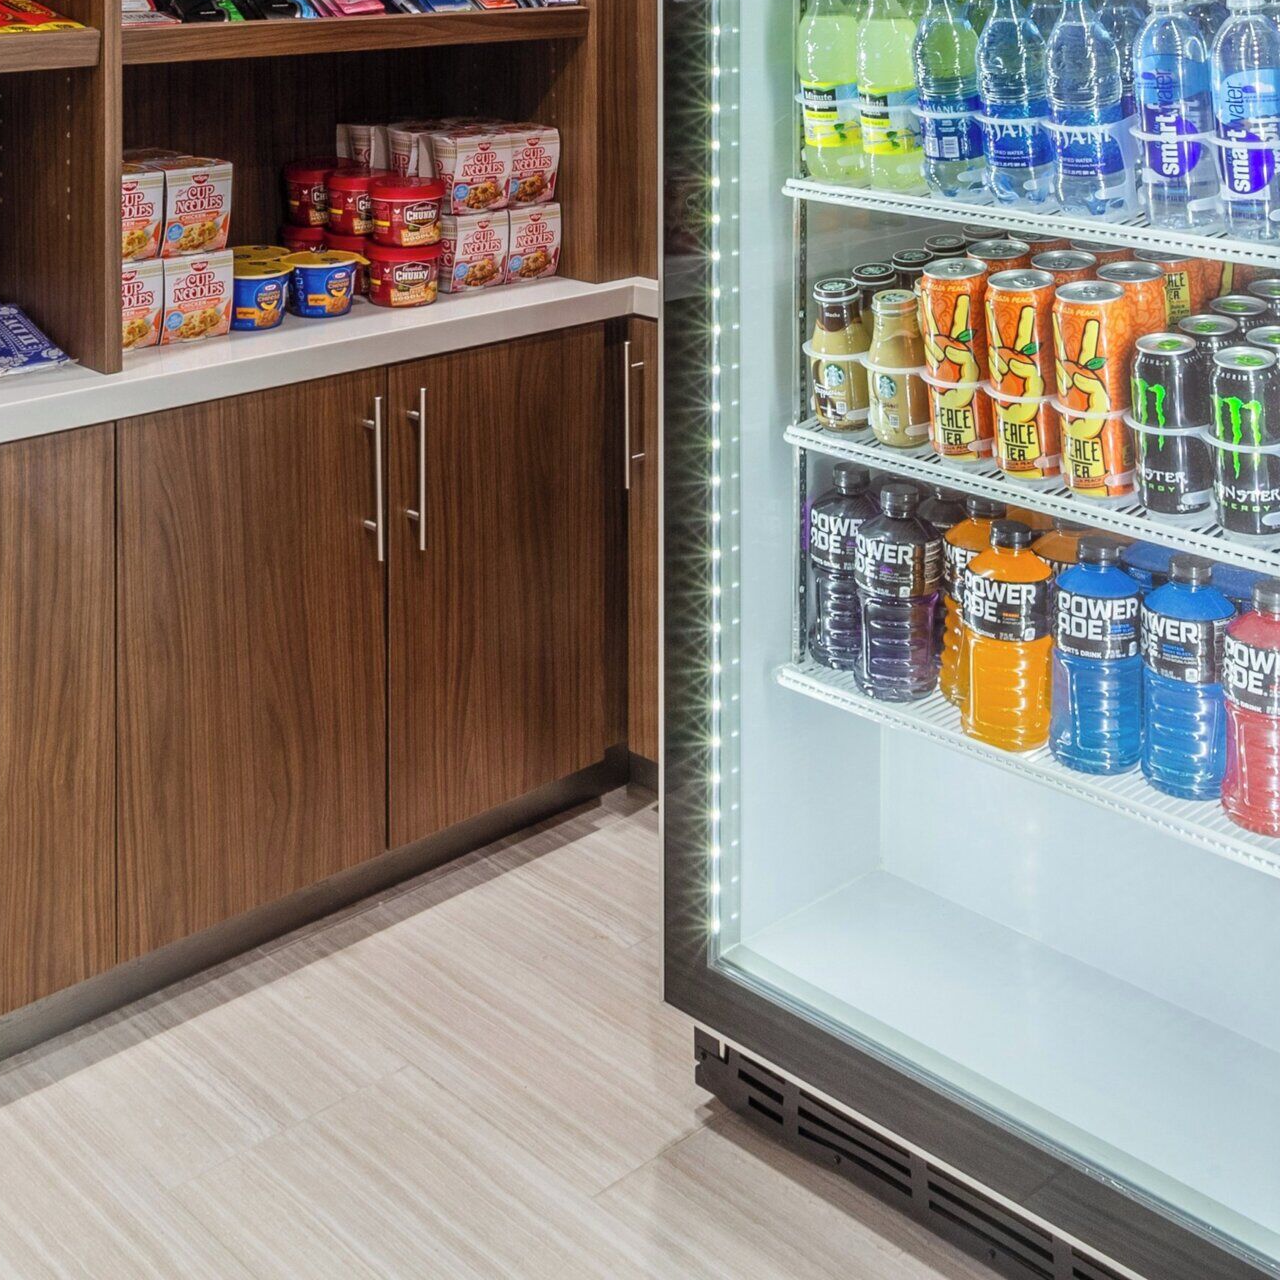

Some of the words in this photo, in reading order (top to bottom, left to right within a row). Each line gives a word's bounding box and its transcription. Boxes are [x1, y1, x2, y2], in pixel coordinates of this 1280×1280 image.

[473, 152, 496, 164] CUP
[522, 147, 545, 159] CUP
[462, 162, 504, 177] NOODLES
[512, 157, 552, 171] NOODLES
[187, 185, 215, 200] CUP
[175, 196, 223, 214] NOODLES
[406, 210, 436, 220] CHUNKY
[525, 222, 547, 234] CUP
[473, 230, 495, 242] CUP
[516, 232, 555, 248] NOODLES
[462, 239, 501, 255] NOODLES
[185, 272, 215, 286] CUP
[395, 269, 428, 280] CHUNKY
[173, 283, 224, 303] NOODLES
[965, 571, 1036, 605] POWER
[1058, 591, 1139, 621] POWER
[1080, 650, 1102, 659] DRINK
[1241, 703, 1262, 713] DRINK
